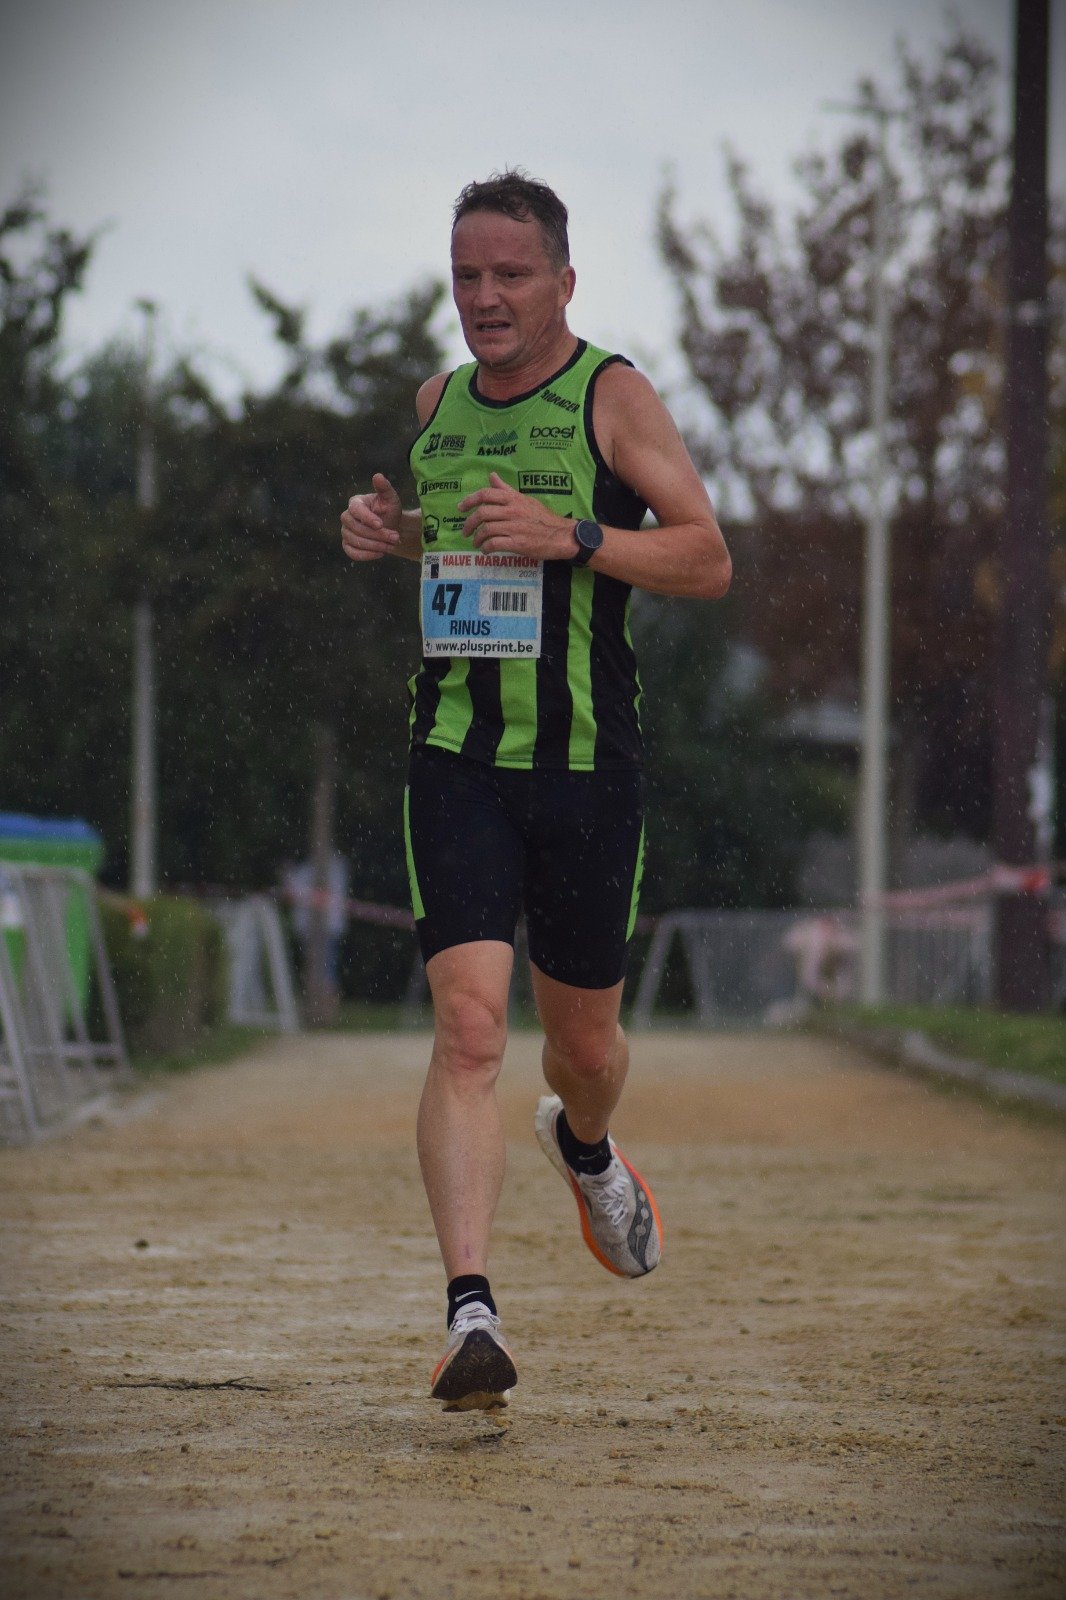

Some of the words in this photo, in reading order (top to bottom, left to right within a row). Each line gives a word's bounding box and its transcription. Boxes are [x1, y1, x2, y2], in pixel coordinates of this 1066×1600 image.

[540, 389, 580, 413] BIORACER
[428, 480, 459, 491] EXPERTS
[522, 474, 569, 487] FIESIEK
[442, 555, 472, 567] HALVE
[474, 555, 539, 567] MARATHON
[431, 583, 463, 616] 47
[449, 620, 491, 636] RINUS
[435, 640, 534, 655] www.plusprint.be
